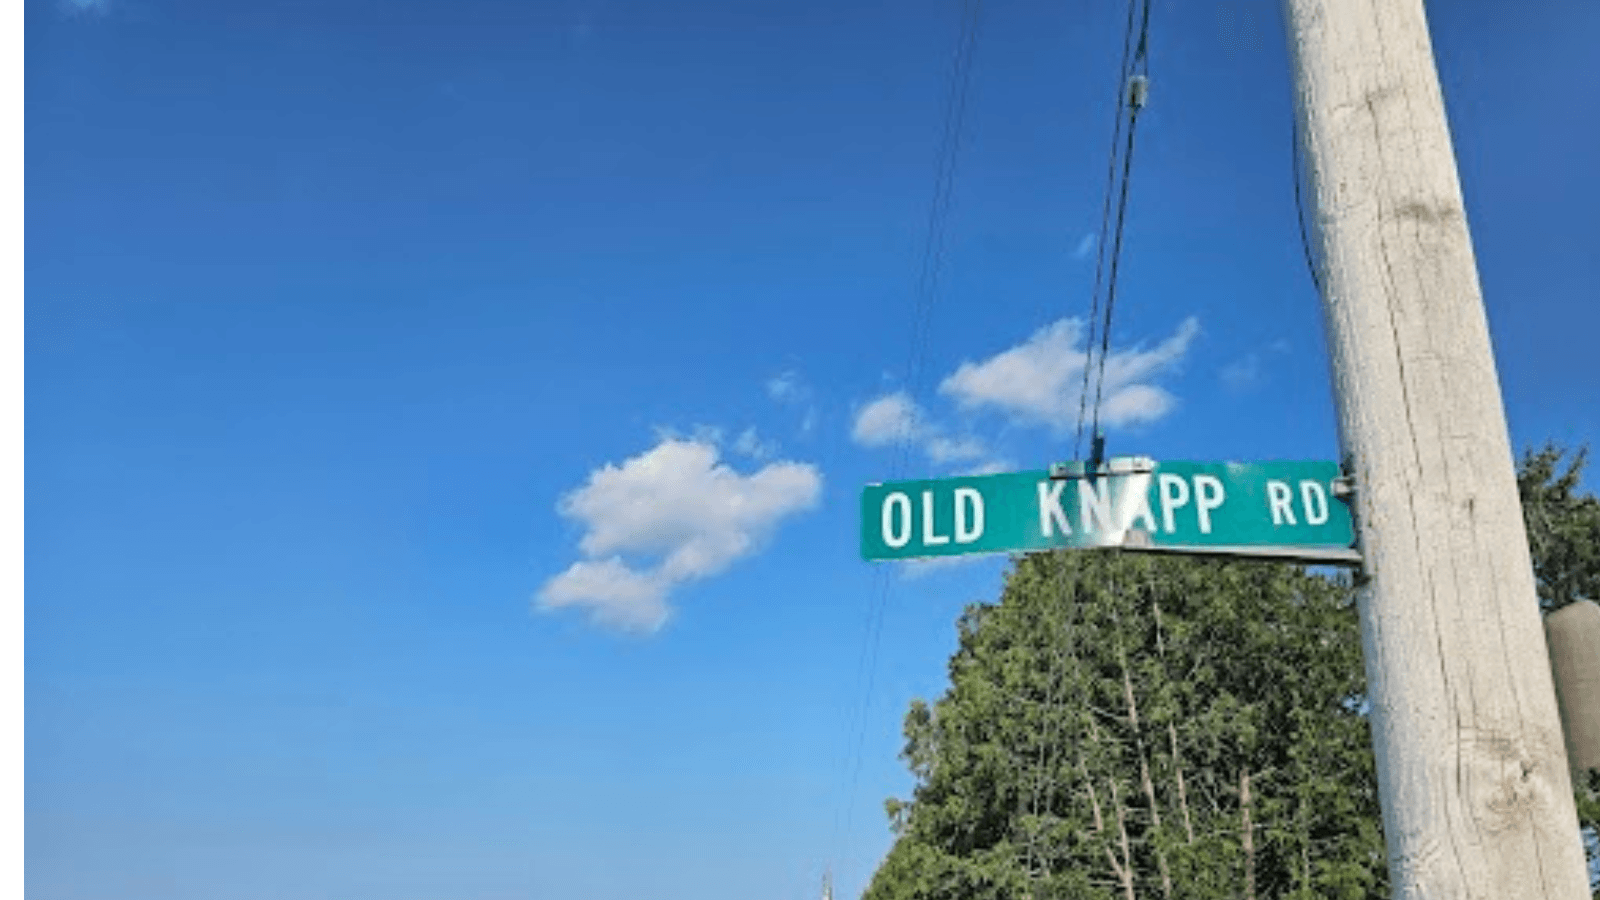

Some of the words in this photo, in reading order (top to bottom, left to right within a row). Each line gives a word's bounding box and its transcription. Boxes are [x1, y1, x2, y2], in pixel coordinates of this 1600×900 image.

[881, 487, 985, 547] OLD
[1037, 473, 1225, 537] KNAPP
[1267, 479, 1329, 526] RD
